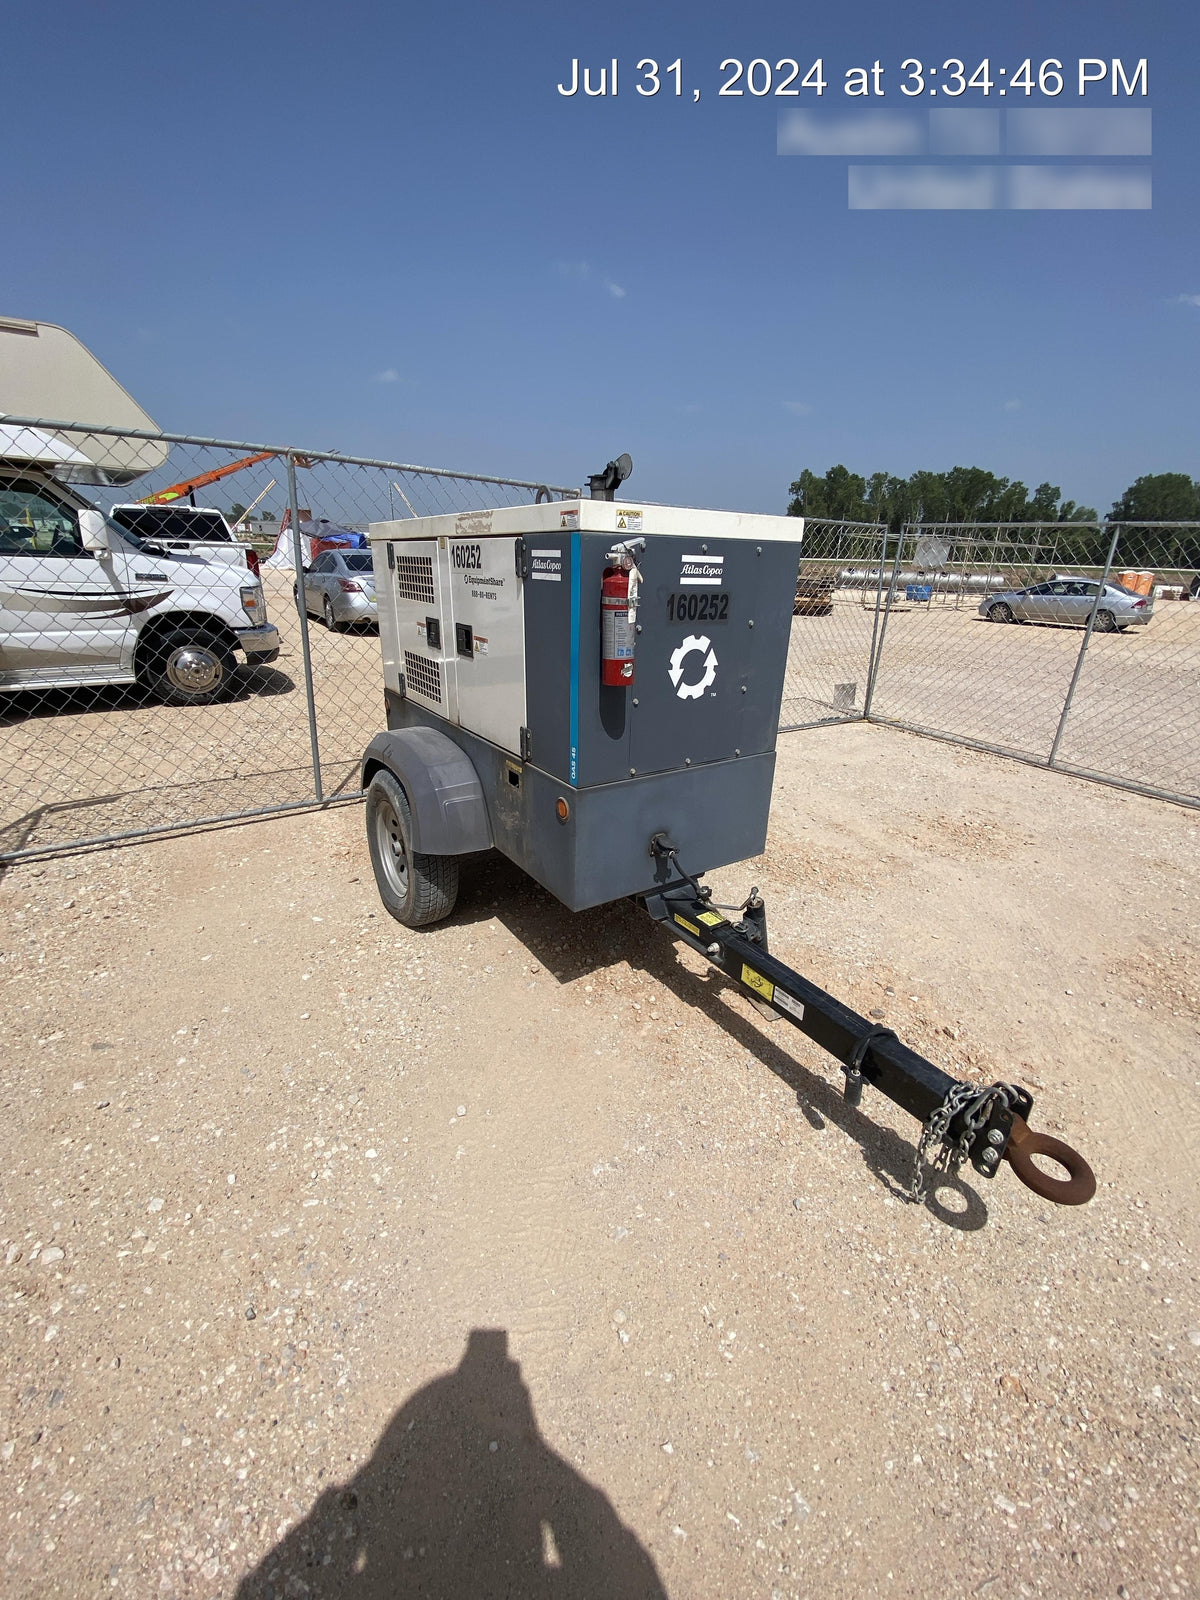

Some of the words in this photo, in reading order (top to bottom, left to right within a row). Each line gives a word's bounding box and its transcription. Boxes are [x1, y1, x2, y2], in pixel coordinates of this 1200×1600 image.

[451, 544, 482, 569] 160252
[531, 558, 547, 569] Atlas
[546, 559, 562, 572] Copco
[680, 564, 703, 575] Atlas
[702, 565, 724, 577] Copco
[666, 593, 730, 622] 160252
